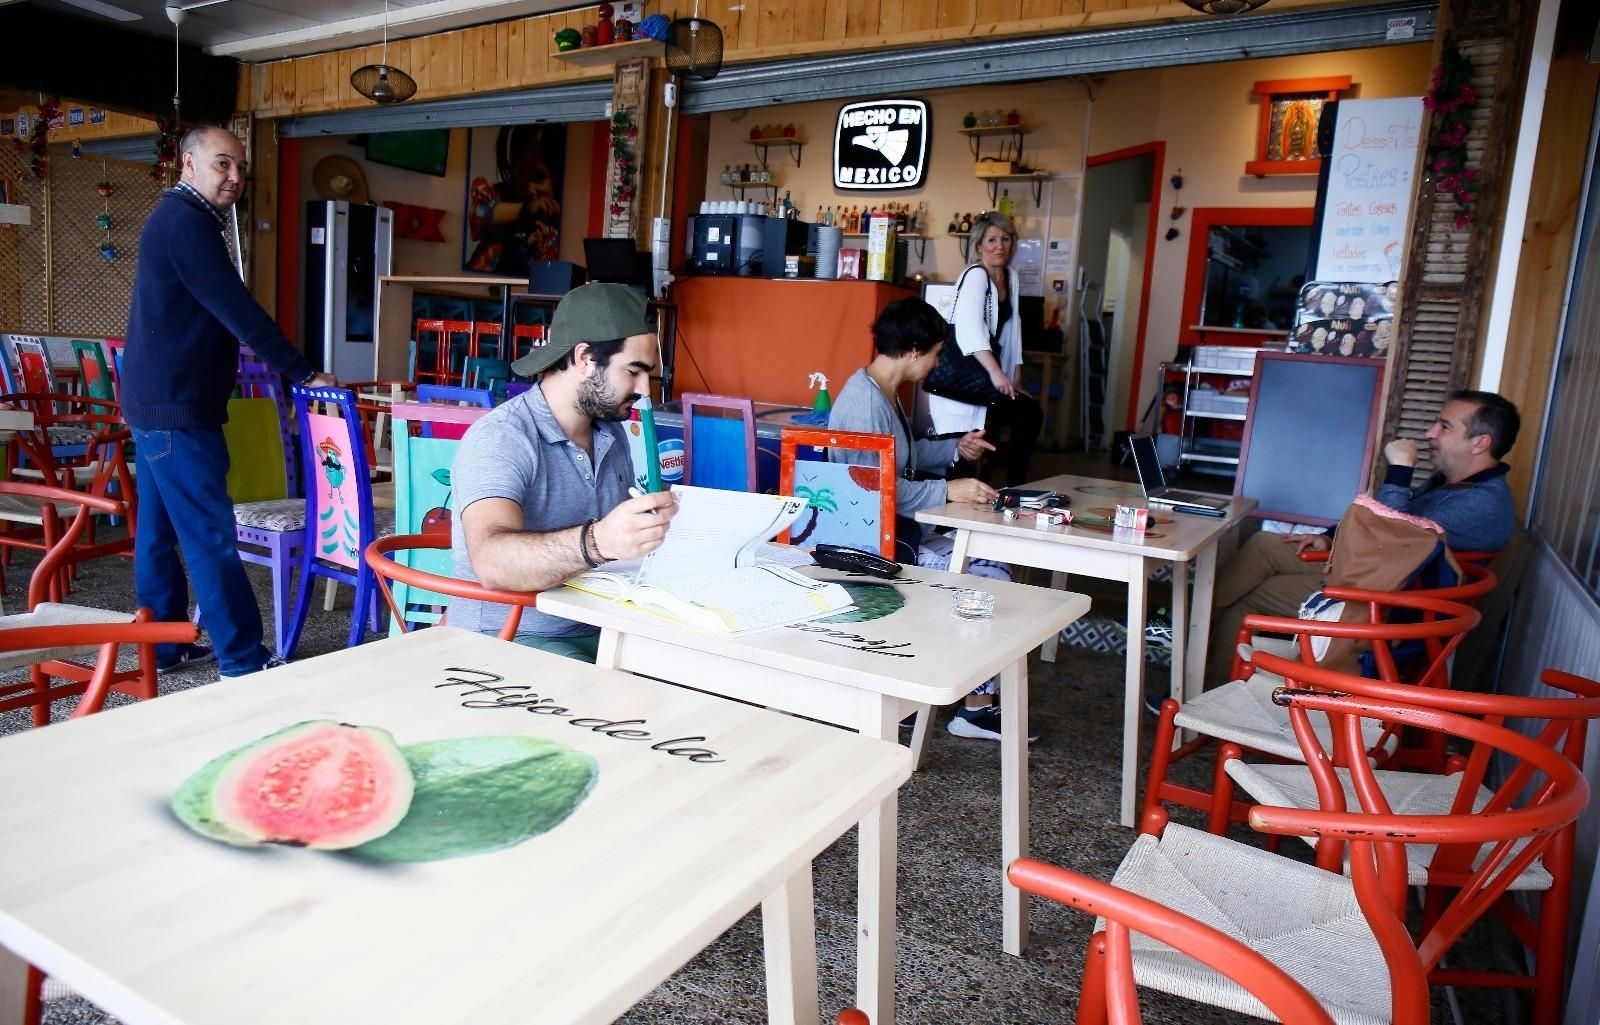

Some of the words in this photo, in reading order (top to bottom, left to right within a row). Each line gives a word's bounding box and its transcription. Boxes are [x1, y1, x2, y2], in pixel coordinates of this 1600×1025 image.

[843, 107, 896, 128] HECHO
[898, 108, 921, 125] EN
[839, 165, 917, 184] MEXICO
[434, 667, 574, 717] Hija
[568, 718, 653, 741] de
[651, 736, 727, 764] la
